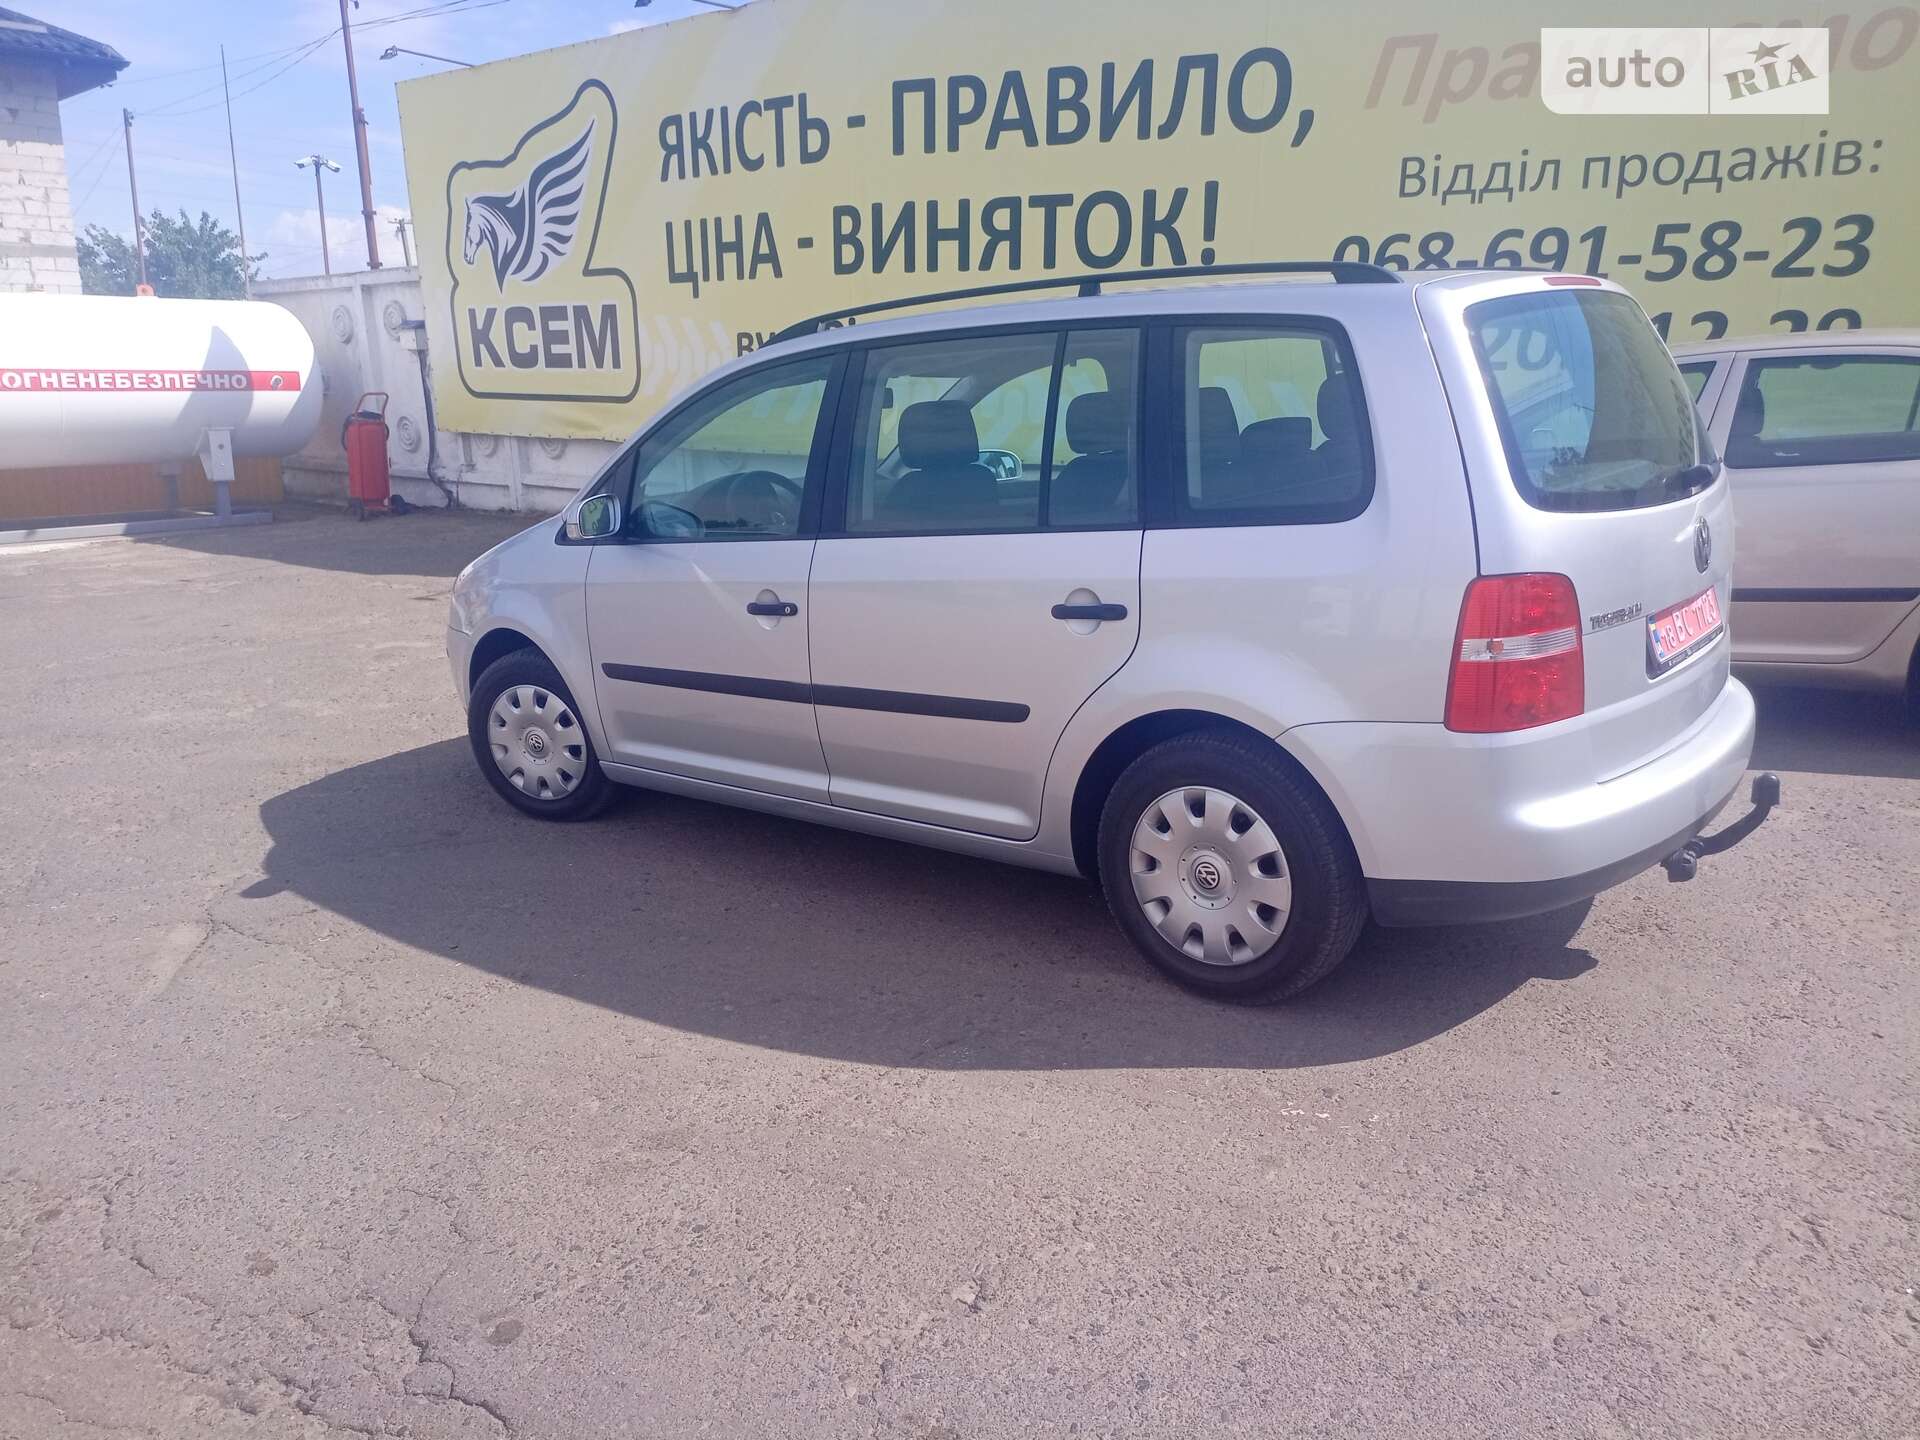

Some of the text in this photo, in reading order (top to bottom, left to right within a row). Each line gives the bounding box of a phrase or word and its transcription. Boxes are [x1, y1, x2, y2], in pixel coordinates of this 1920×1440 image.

[658, 92, 831, 182] ЯКІСТЬ
[891, 46, 1315, 155] ПРАВИЛО,
[1399, 130, 1883, 205] Відділ продажів:
[665, 211, 783, 299] ЦІНА
[832, 180, 1220, 274] ВИНЯТОК!
[1333, 214, 1875, 283] 068-691-58-23
[467, 303, 622, 370] КСЕМ
[0, 371, 248, 390] ОГНЕНЕБЕЗПЕЧНО
